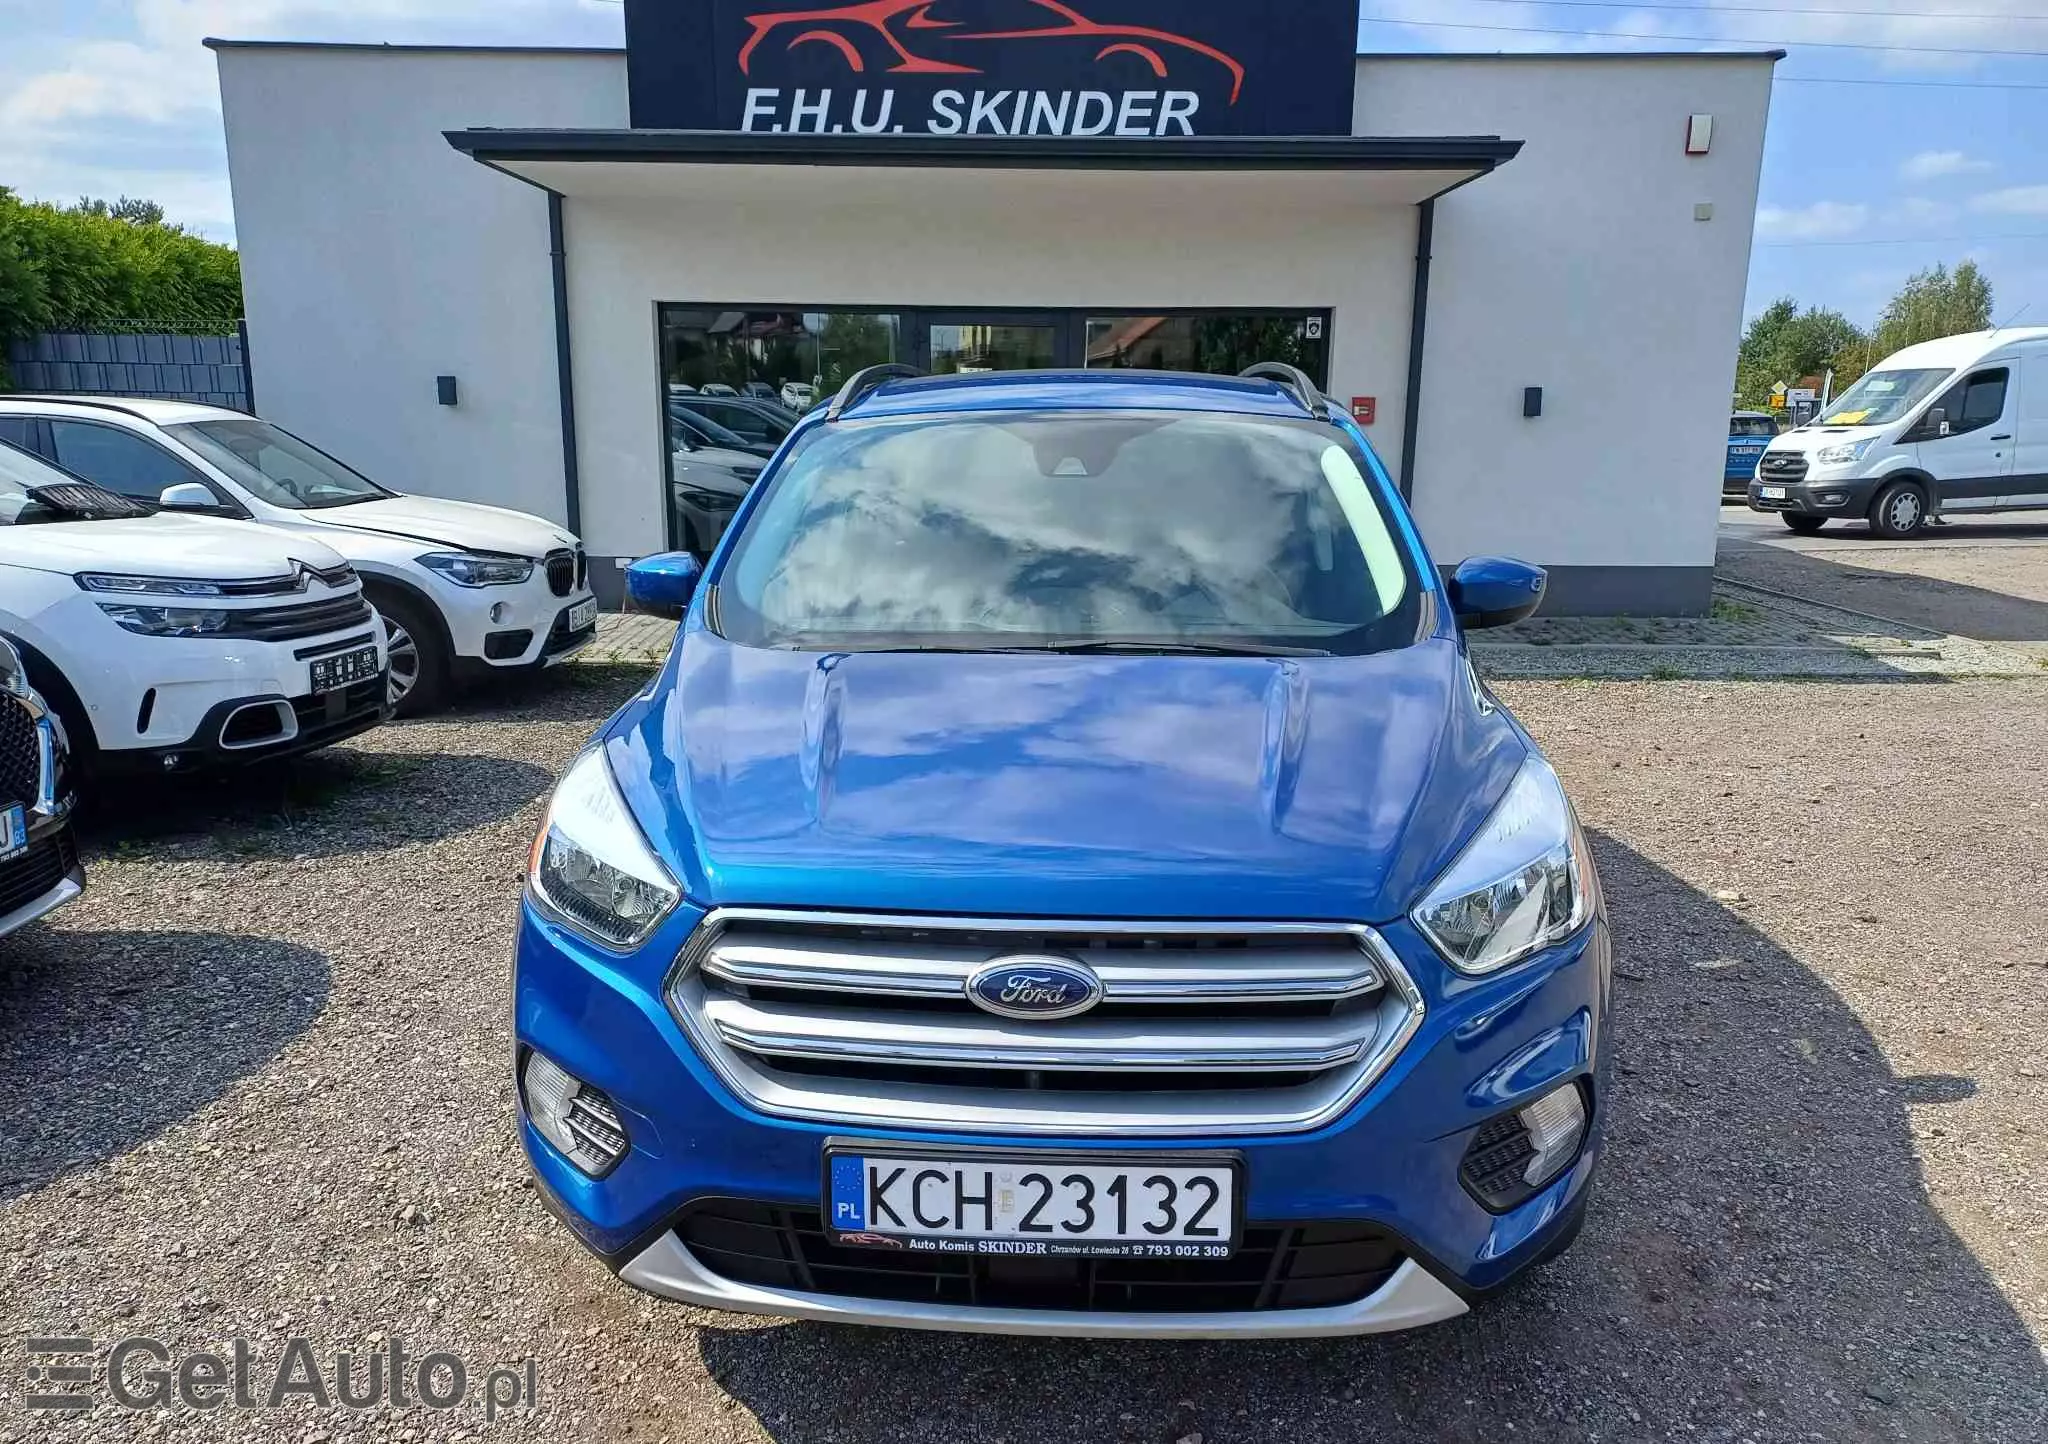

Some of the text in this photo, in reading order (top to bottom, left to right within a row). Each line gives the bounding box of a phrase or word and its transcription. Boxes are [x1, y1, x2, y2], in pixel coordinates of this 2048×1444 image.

[741, 88, 1199, 136] F.H.U. SKINDER
[1000, 974, 1067, 1004] Ford
[837, 1202, 860, 1220] PL
[869, 1166, 1219, 1236] KCH 23132
[909, 1239, 936, 1250] Auto
[939, 1240, 975, 1252] Komis
[978, 1241, 1047, 1254] SKINDER
[1146, 1245, 1172, 1255] 793
[1175, 1246, 1200, 1256] 002
[1203, 1246, 1229, 1257] 309
